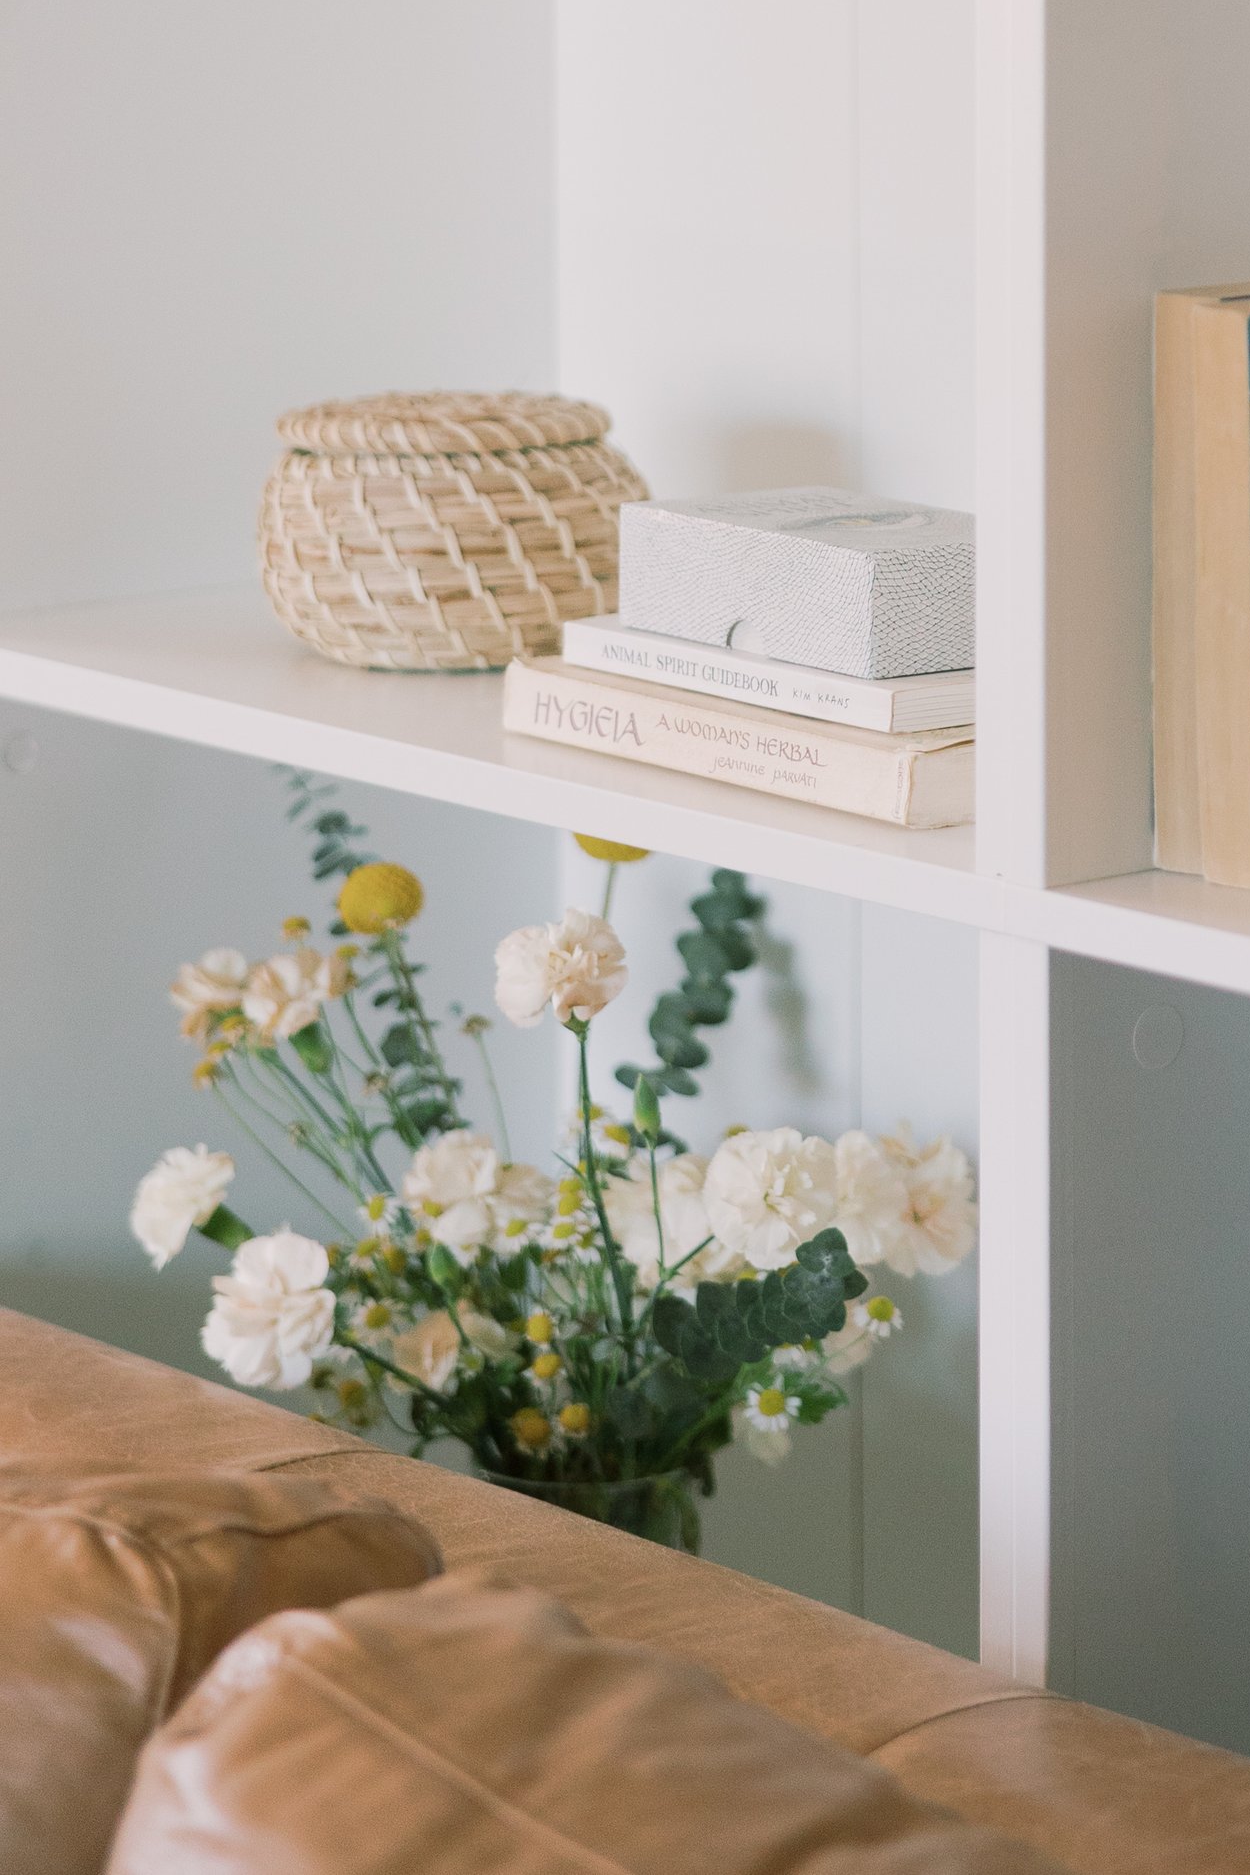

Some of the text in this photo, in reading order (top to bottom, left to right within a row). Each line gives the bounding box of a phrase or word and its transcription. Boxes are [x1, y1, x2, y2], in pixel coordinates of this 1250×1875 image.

[601, 643, 651, 668] ANIMAL
[656, 654, 698, 677] SPIRIT
[702, 666, 779, 697] GUIDEBOOK
[817, 691, 851, 709] KRANS
[534, 691, 645, 746] HYGIEIA
[656, 713, 671, 731] A
[757, 729, 828, 768] HERBAL
